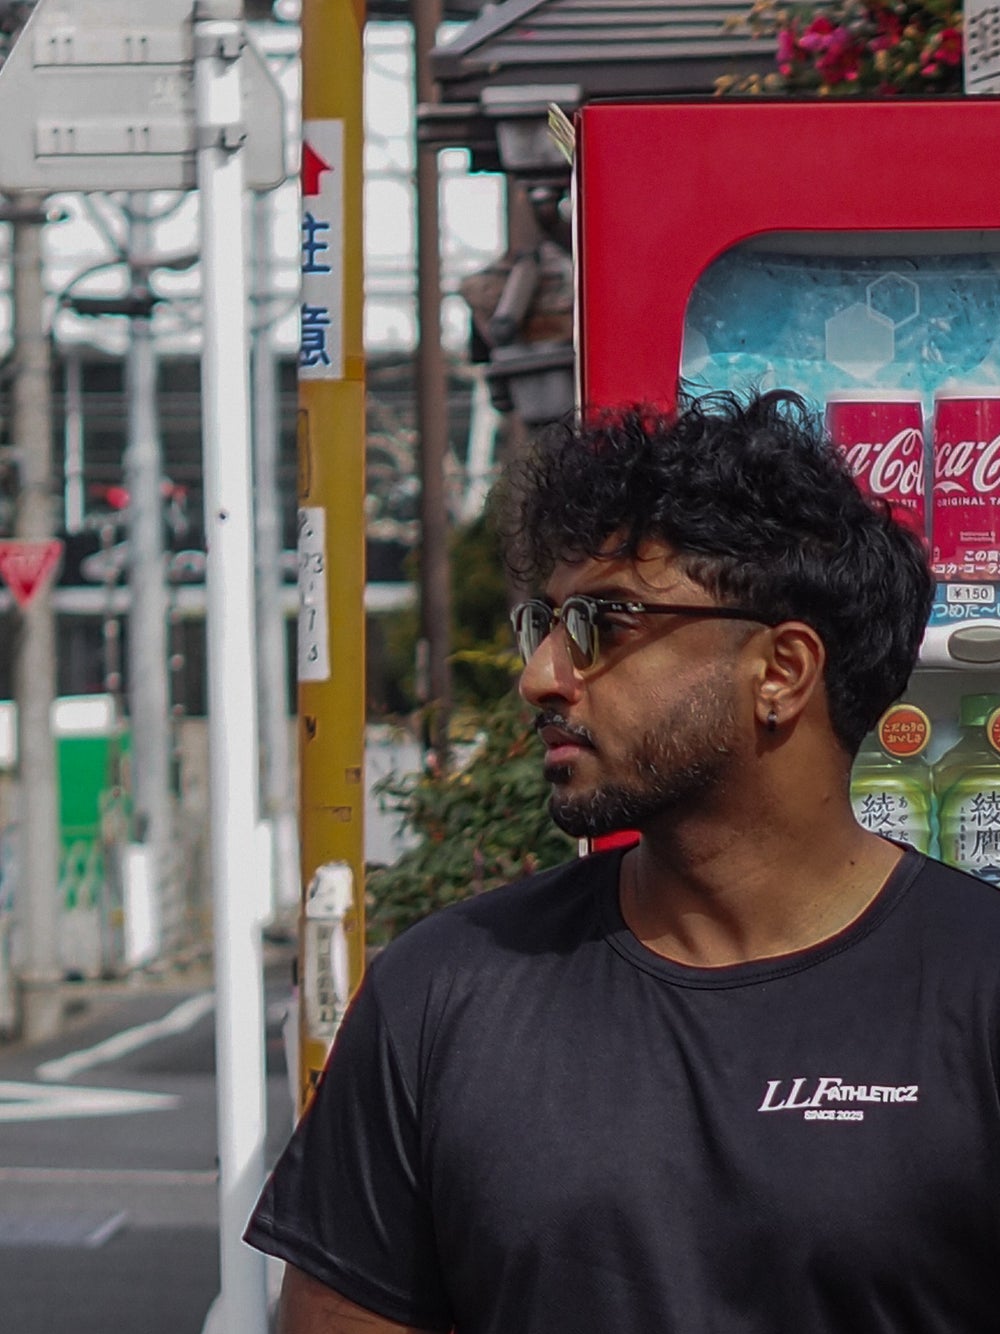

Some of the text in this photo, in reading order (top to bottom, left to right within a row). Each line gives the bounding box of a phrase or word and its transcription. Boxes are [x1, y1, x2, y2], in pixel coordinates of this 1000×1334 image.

[937, 497, 986, 507] ORIGINAL
[954, 588, 989, 598] ¥150
[804, 1110, 835, 1120] SINCE
